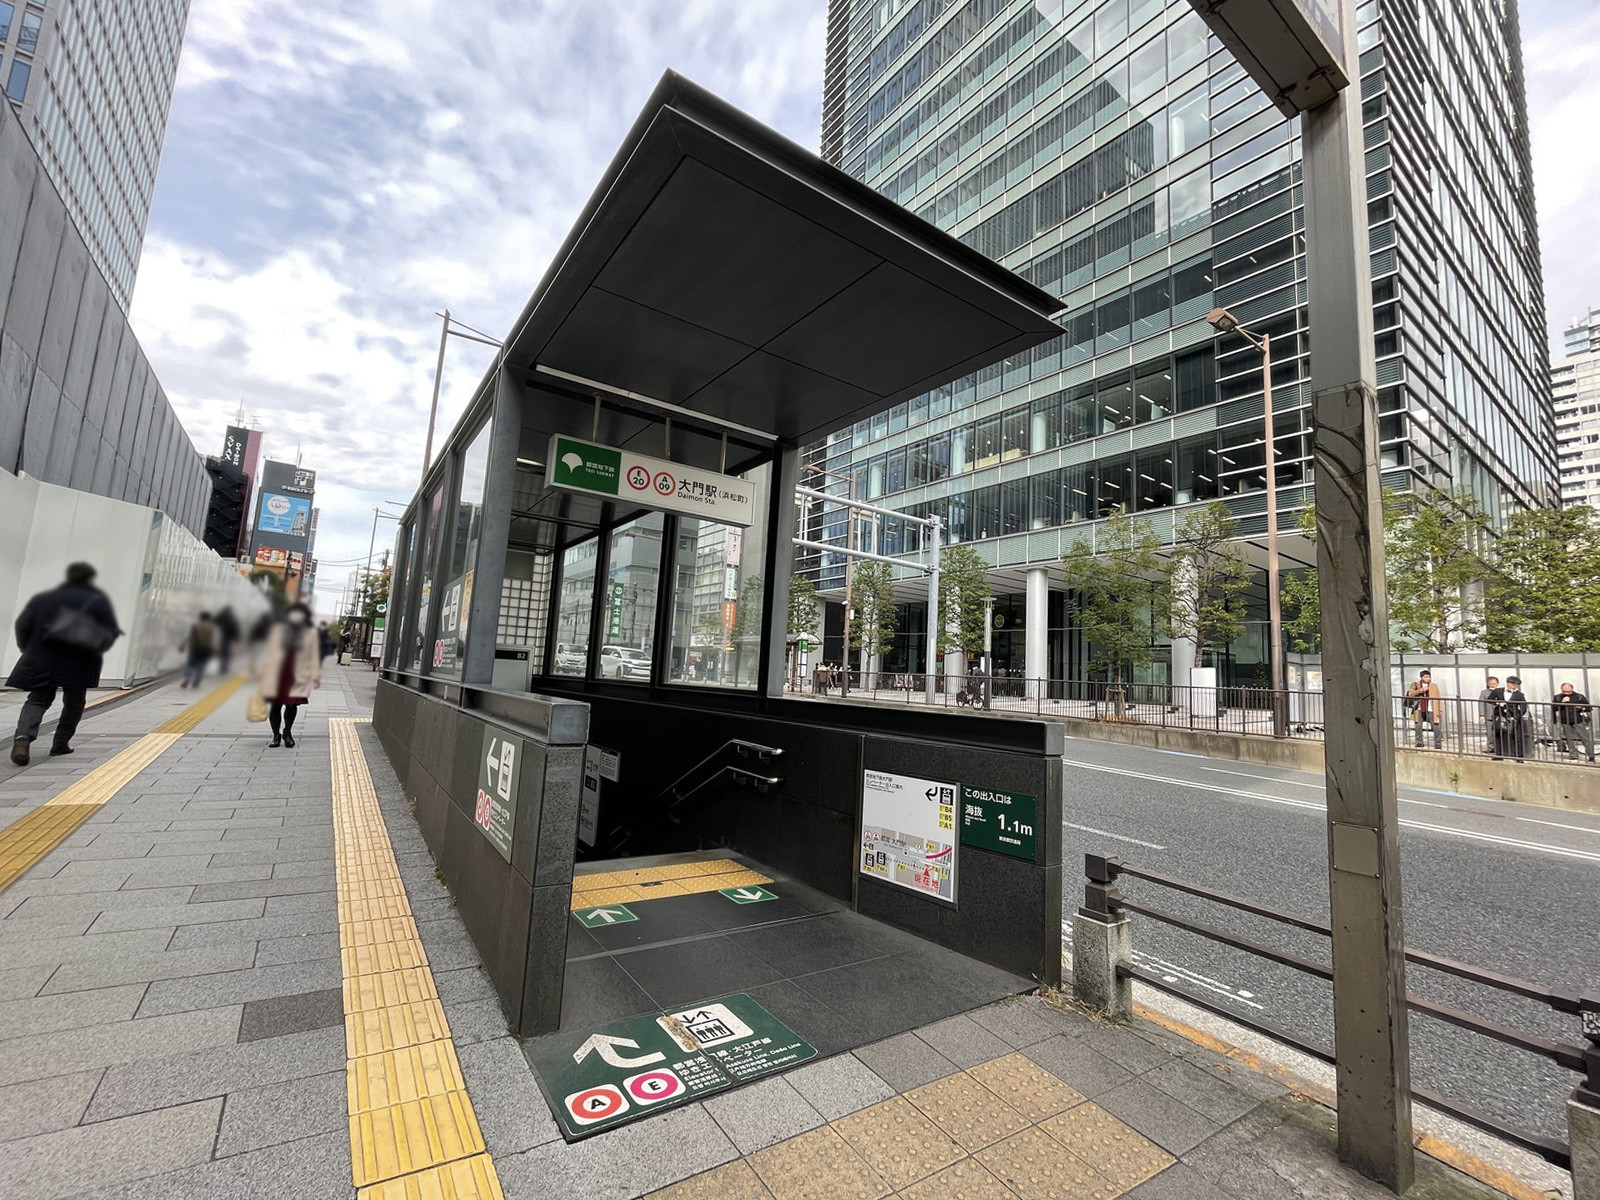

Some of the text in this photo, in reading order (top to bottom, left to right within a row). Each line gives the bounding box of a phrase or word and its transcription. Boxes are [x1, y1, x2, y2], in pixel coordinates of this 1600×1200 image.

[232, 442, 241, 466] DAIMON
[632, 476, 645, 486] 20
[658, 482, 670, 492] 09
[677, 491, 717, 506] Daimon Sta.
[964, 788, 1012, 806] この出入口は
[944, 806, 953, 814] B4
[964, 804, 983, 818] 海抜
[944, 814, 953, 822] B5
[997, 813, 1033, 837] 1.1m
[944, 822, 953, 830] A1
[914, 873, 939, 889] 現在地
[684, 1068, 715, 1082] Elevator
[725, 1057, 754, 1069] Asakusa
[753, 1051, 771, 1060] Line,
[771, 1047, 788, 1056] Oedo
[787, 1042, 802, 1051] Line
[649, 1080, 661, 1092] E
[589, 1097, 606, 1111] A
